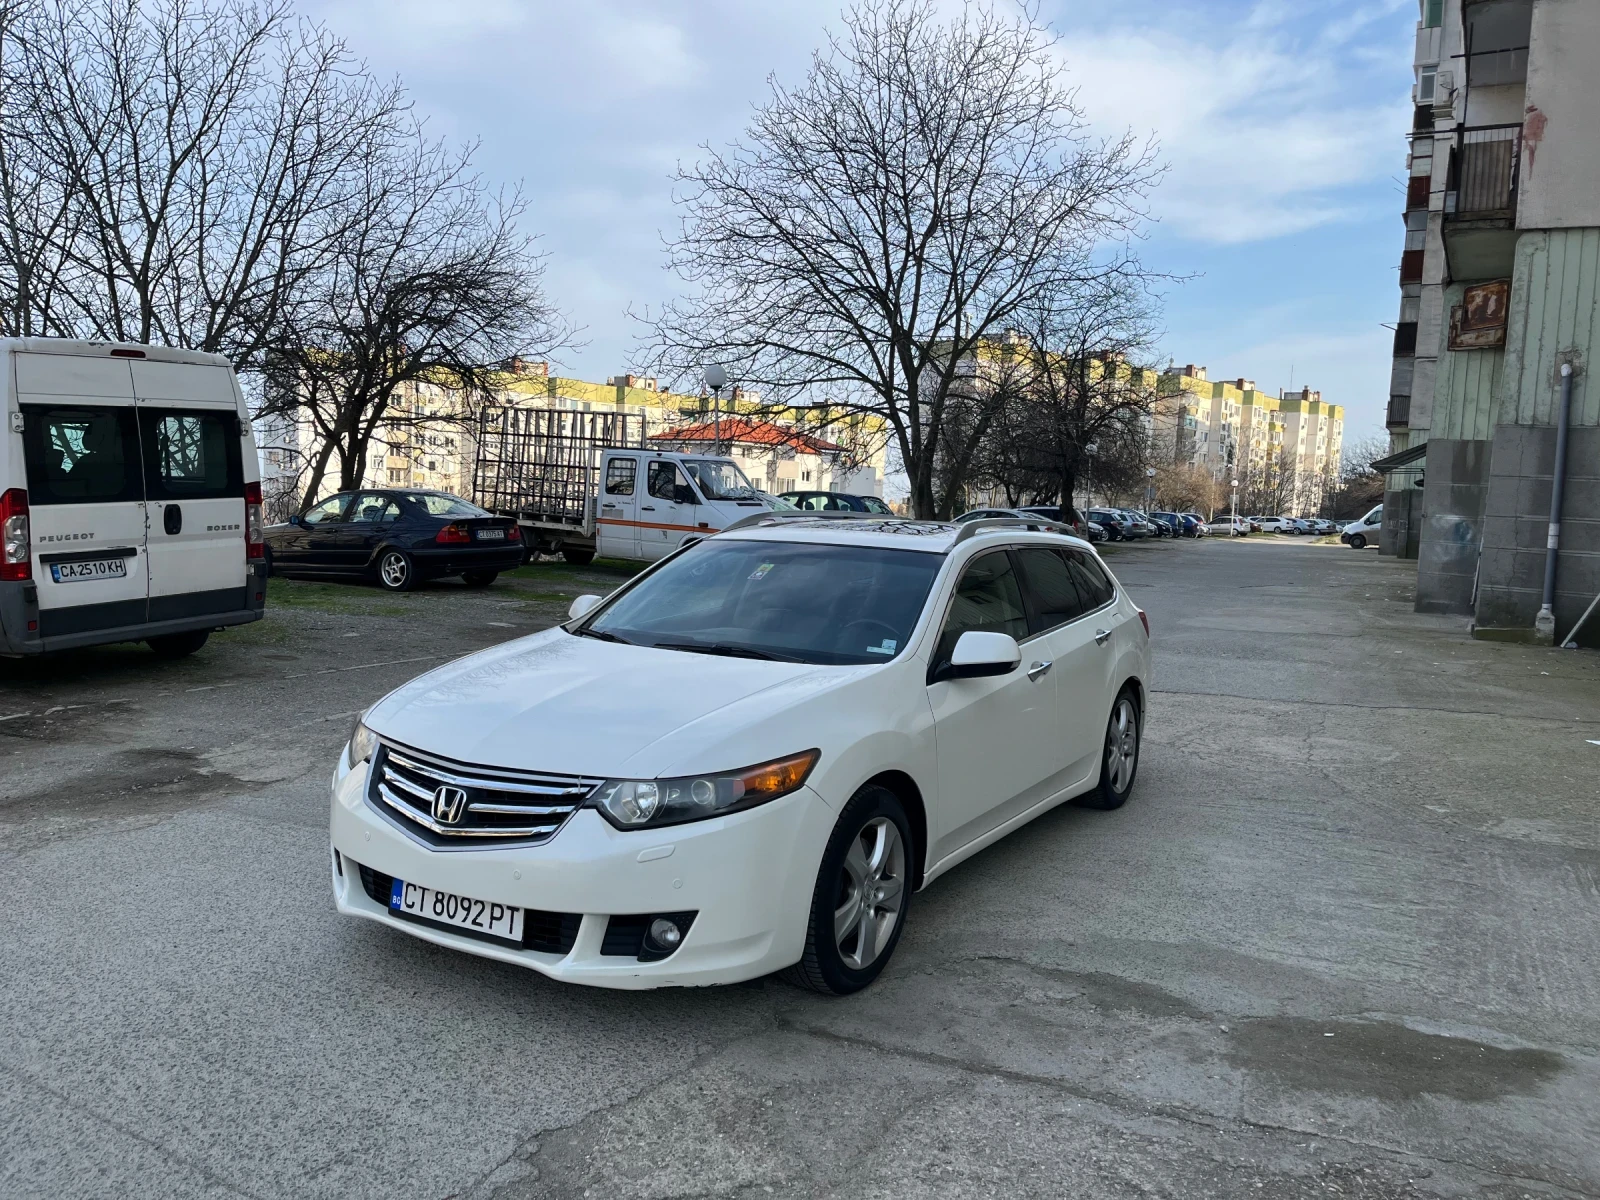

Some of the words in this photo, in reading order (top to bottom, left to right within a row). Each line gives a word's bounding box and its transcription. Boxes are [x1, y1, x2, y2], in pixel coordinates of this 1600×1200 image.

[206, 524, 241, 532] BOXER
[39, 532, 95, 543] PEUGEOT
[60, 564, 77, 577] CA
[77, 562, 106, 576] 2510
[106, 560, 124, 573] KH
[392, 895, 401, 905] BG
[404, 882, 431, 912] CT
[432, 890, 486, 928] 8092
[488, 902, 520, 935] PT
